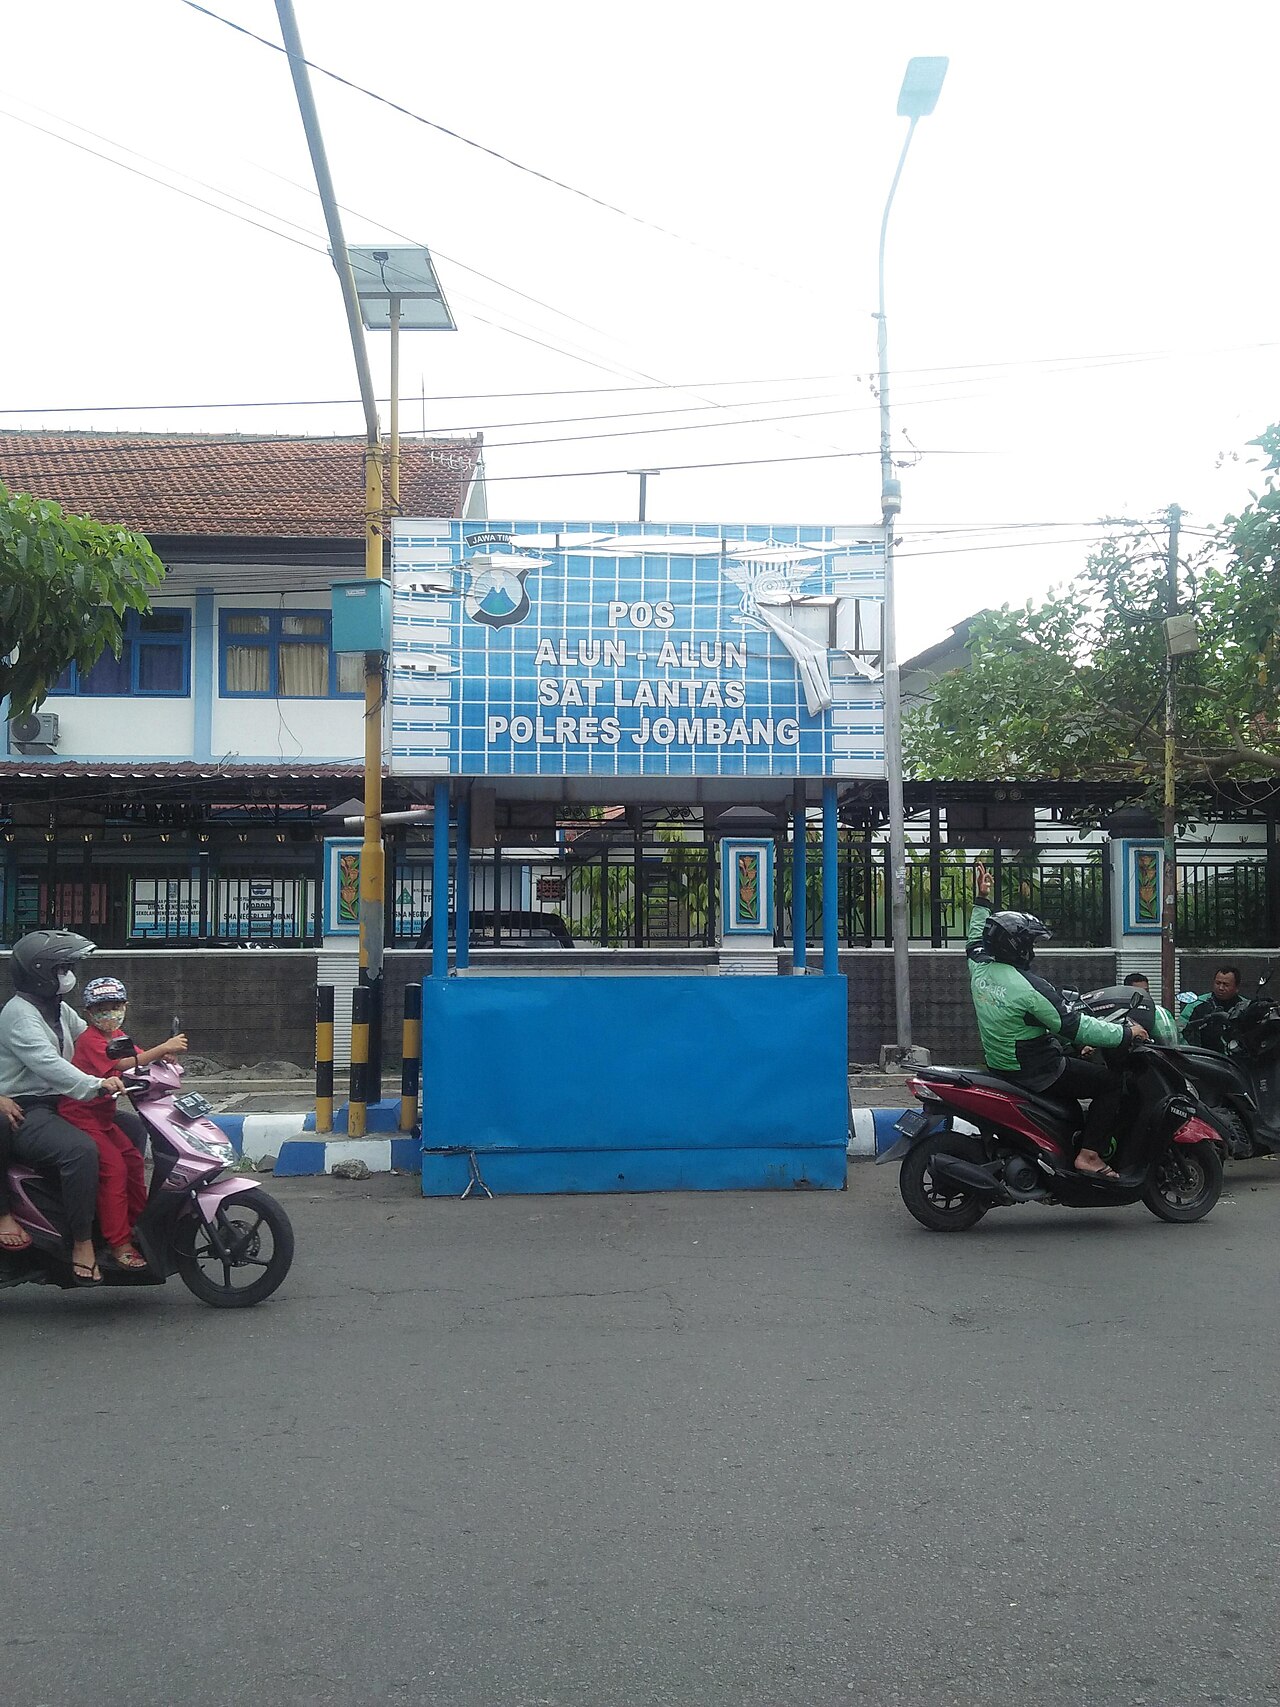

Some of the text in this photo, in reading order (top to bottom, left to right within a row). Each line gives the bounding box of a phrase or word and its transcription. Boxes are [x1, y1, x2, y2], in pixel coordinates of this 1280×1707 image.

[472, 535, 495, 544] JAWA
[608, 601, 675, 629] POS
[534, 638, 627, 667] ALUN
[656, 640, 747, 668] ALUN
[538, 680, 746, 708] SAT LANTAS
[488, 716, 800, 745] POLRES JOMBANG
[1170, 1106, 1188, 1119] YAMAHA
